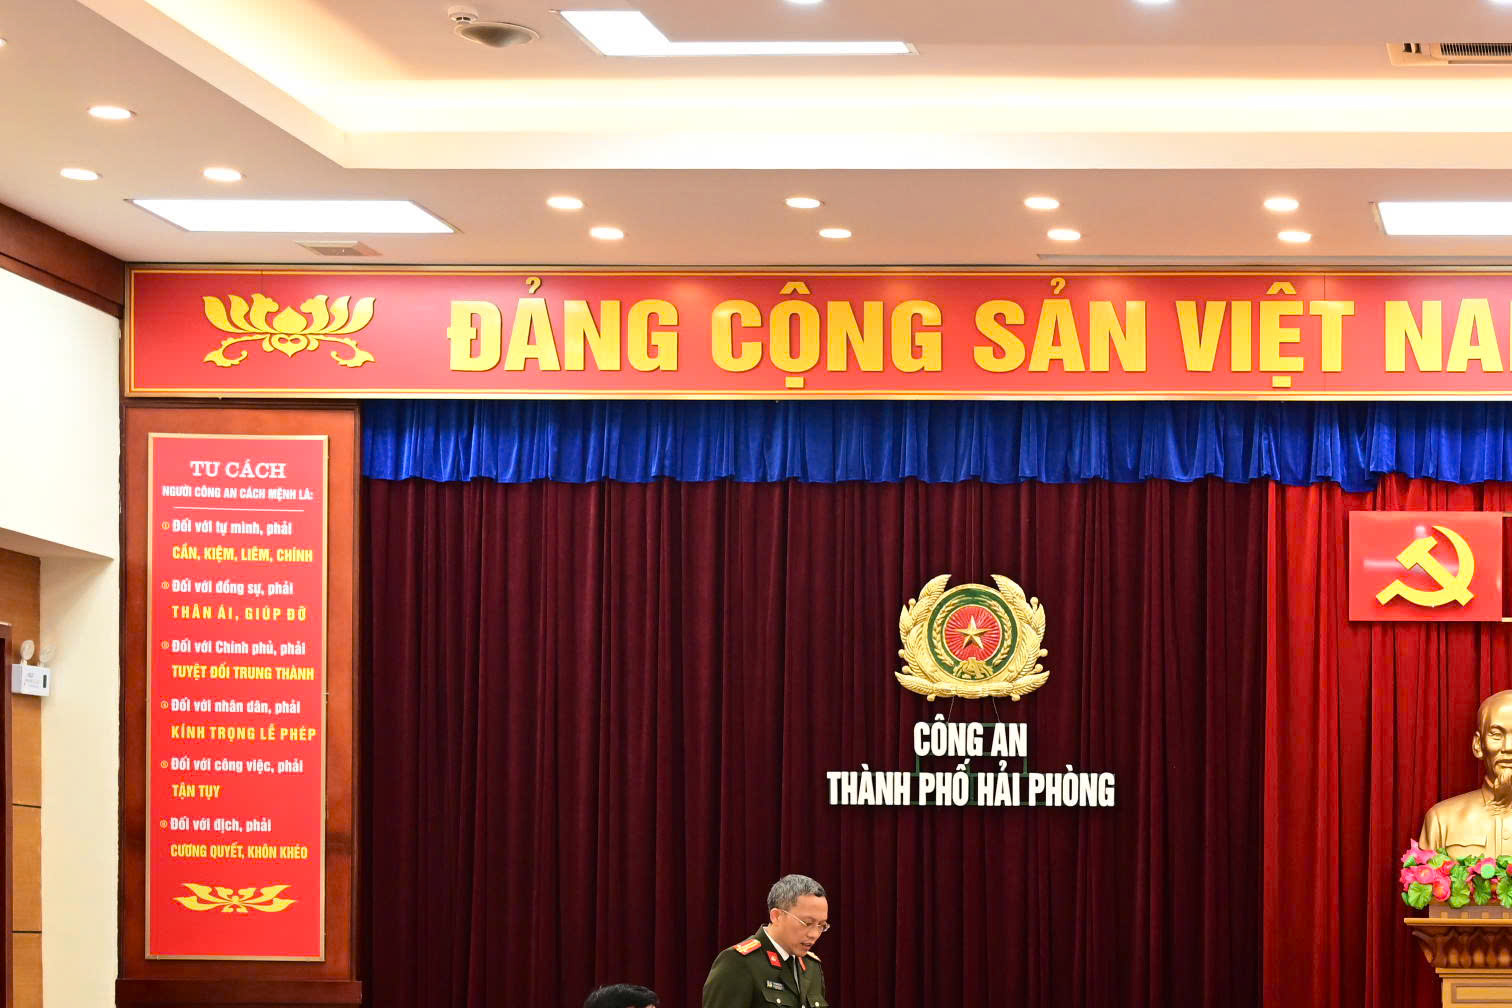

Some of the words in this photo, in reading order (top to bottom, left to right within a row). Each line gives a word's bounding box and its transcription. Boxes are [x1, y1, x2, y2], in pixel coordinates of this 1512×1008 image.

[446, 277, 679, 373] ĐẢNG
[711, 282, 943, 389] CỘNG
[973, 278, 1147, 373] SẢN
[1176, 281, 1354, 388] VIỆT
[914, 714, 983, 756] CÔNG
[991, 723, 1027, 757] AN
[827, 764, 911, 805] THÀNH
[919, 758, 970, 806] PHỐ
[978, 760, 1020, 806] HẢI
[1028, 764, 1115, 806] PHÒNG
